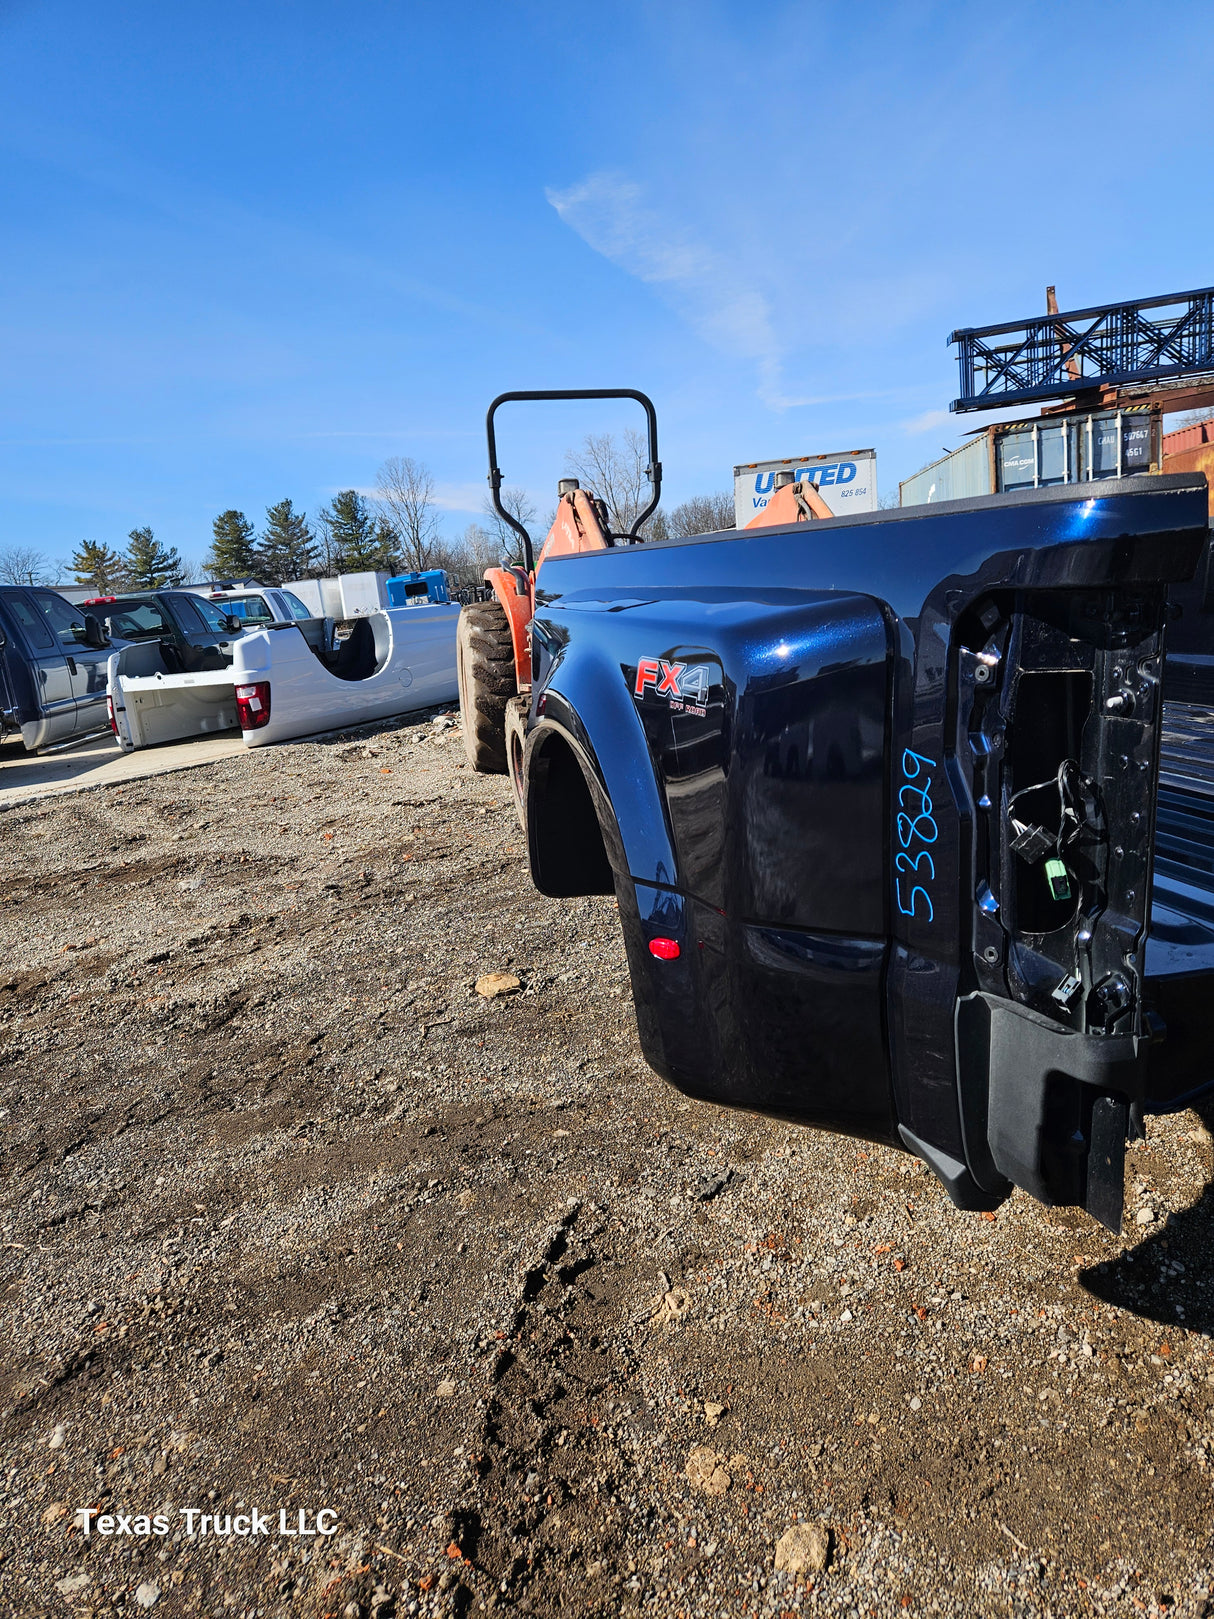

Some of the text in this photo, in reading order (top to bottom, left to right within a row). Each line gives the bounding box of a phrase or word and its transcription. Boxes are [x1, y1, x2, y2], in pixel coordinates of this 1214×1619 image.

[754, 462, 857, 494] UITED
[752, 496, 769, 508] Va
[634, 656, 709, 707] FX4
[895, 748, 939, 922] 53829
